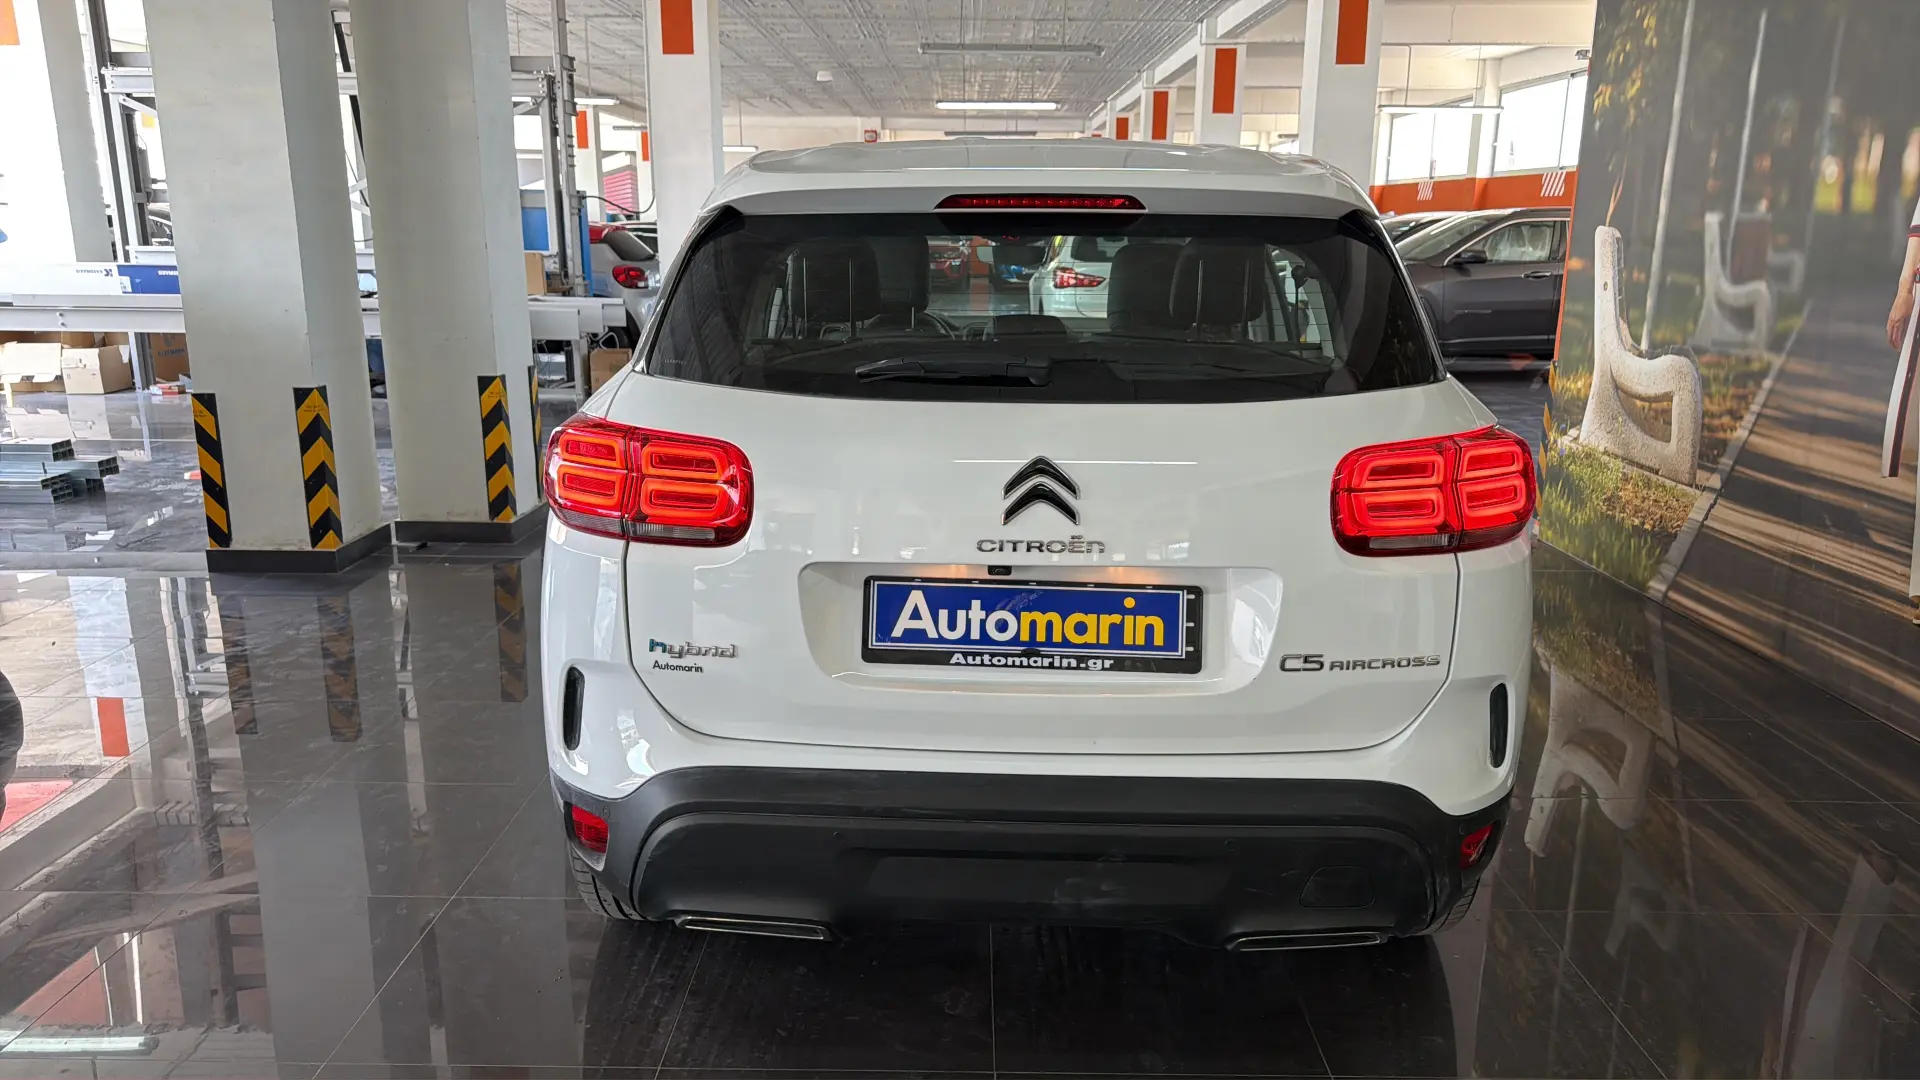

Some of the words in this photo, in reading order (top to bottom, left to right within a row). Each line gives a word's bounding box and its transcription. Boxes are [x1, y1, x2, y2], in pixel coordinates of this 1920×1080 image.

[890, 589, 1165, 647] Automarin
[649, 638, 737, 659] hybrid
[652, 660, 704, 673] Automarin
[949, 652, 1114, 671] Automarin.gr
[1279, 653, 1325, 673] C5
[1328, 654, 1441, 672] AIRCROSS
